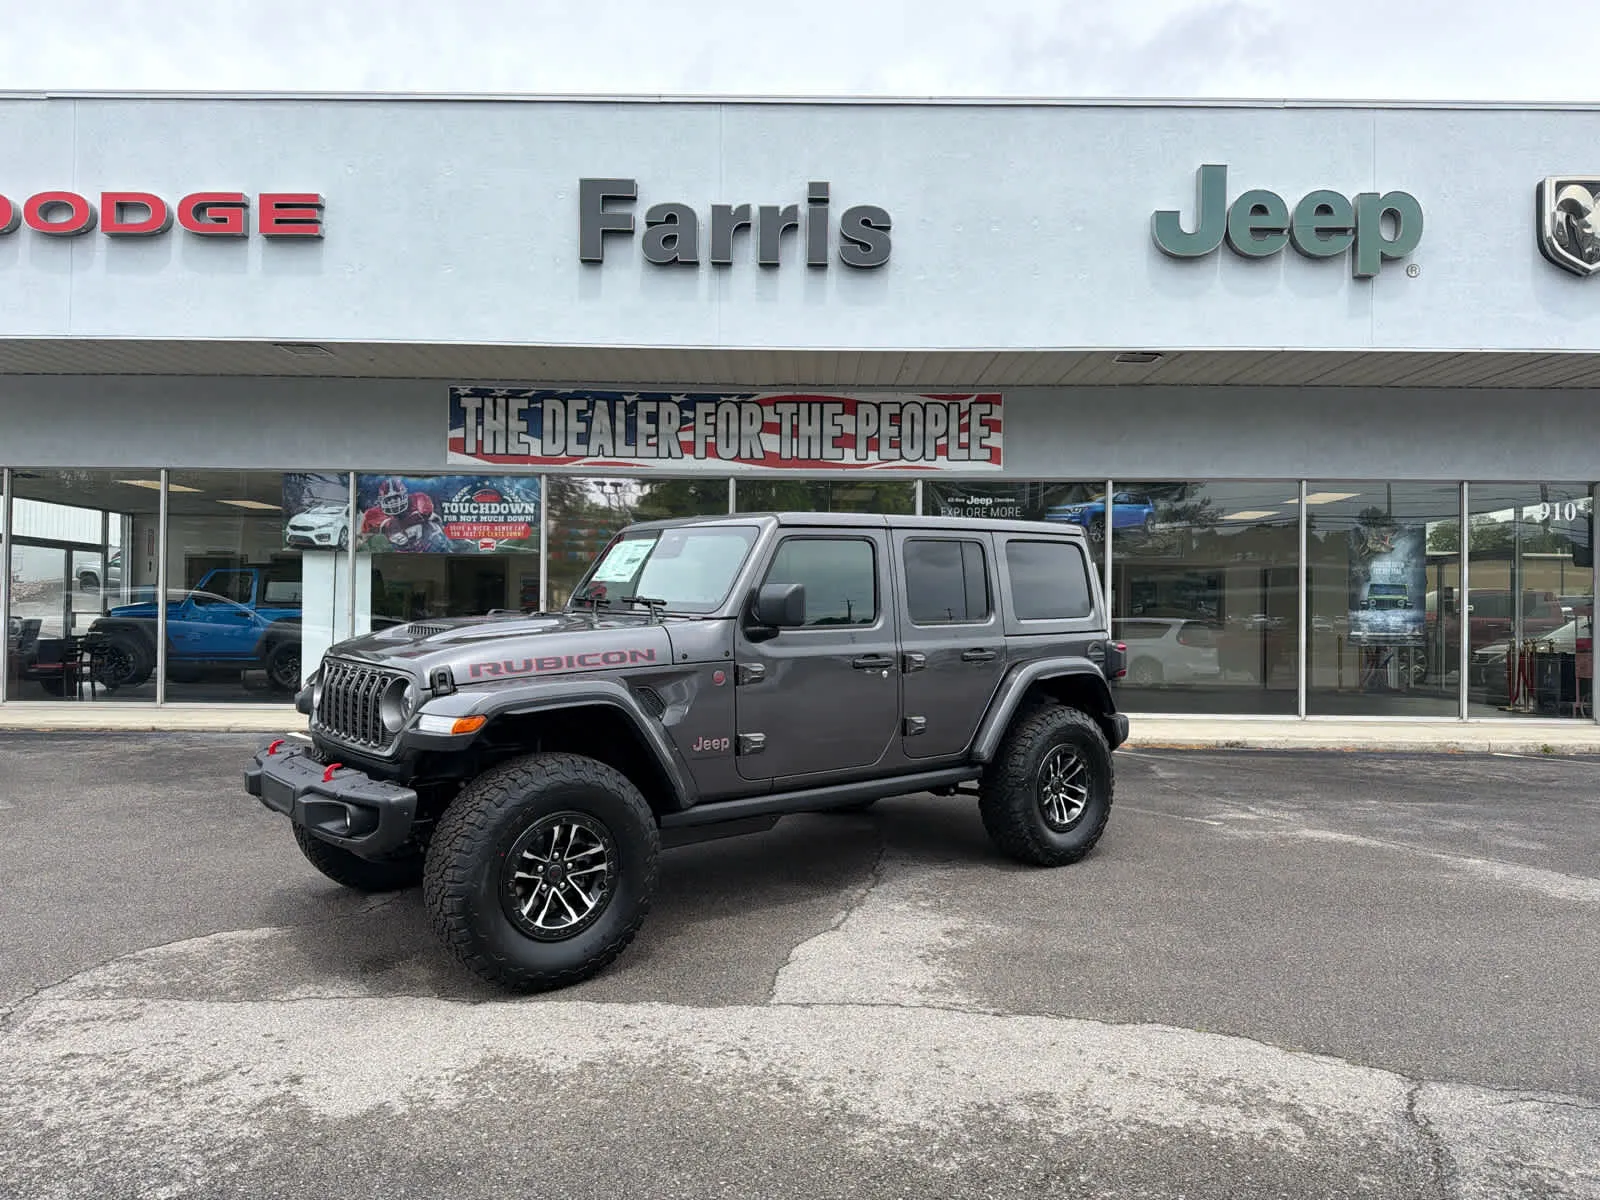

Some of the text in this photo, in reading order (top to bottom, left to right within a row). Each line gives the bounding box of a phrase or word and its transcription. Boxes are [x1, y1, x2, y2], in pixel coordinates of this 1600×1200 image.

[0, 190, 325, 240] ODGE
[579, 178, 892, 267] Farris
[1151, 164, 1424, 279] Jeep
[459, 396, 993, 462] THE DEALER FOR THE PEOPLE
[442, 502, 535, 514] TOUCHDOWN
[941, 506, 987, 517] EXPLORE
[966, 496, 993, 506] Jeep
[469, 648, 657, 678] RUBICON
[692, 736, 730, 752] Jeep
